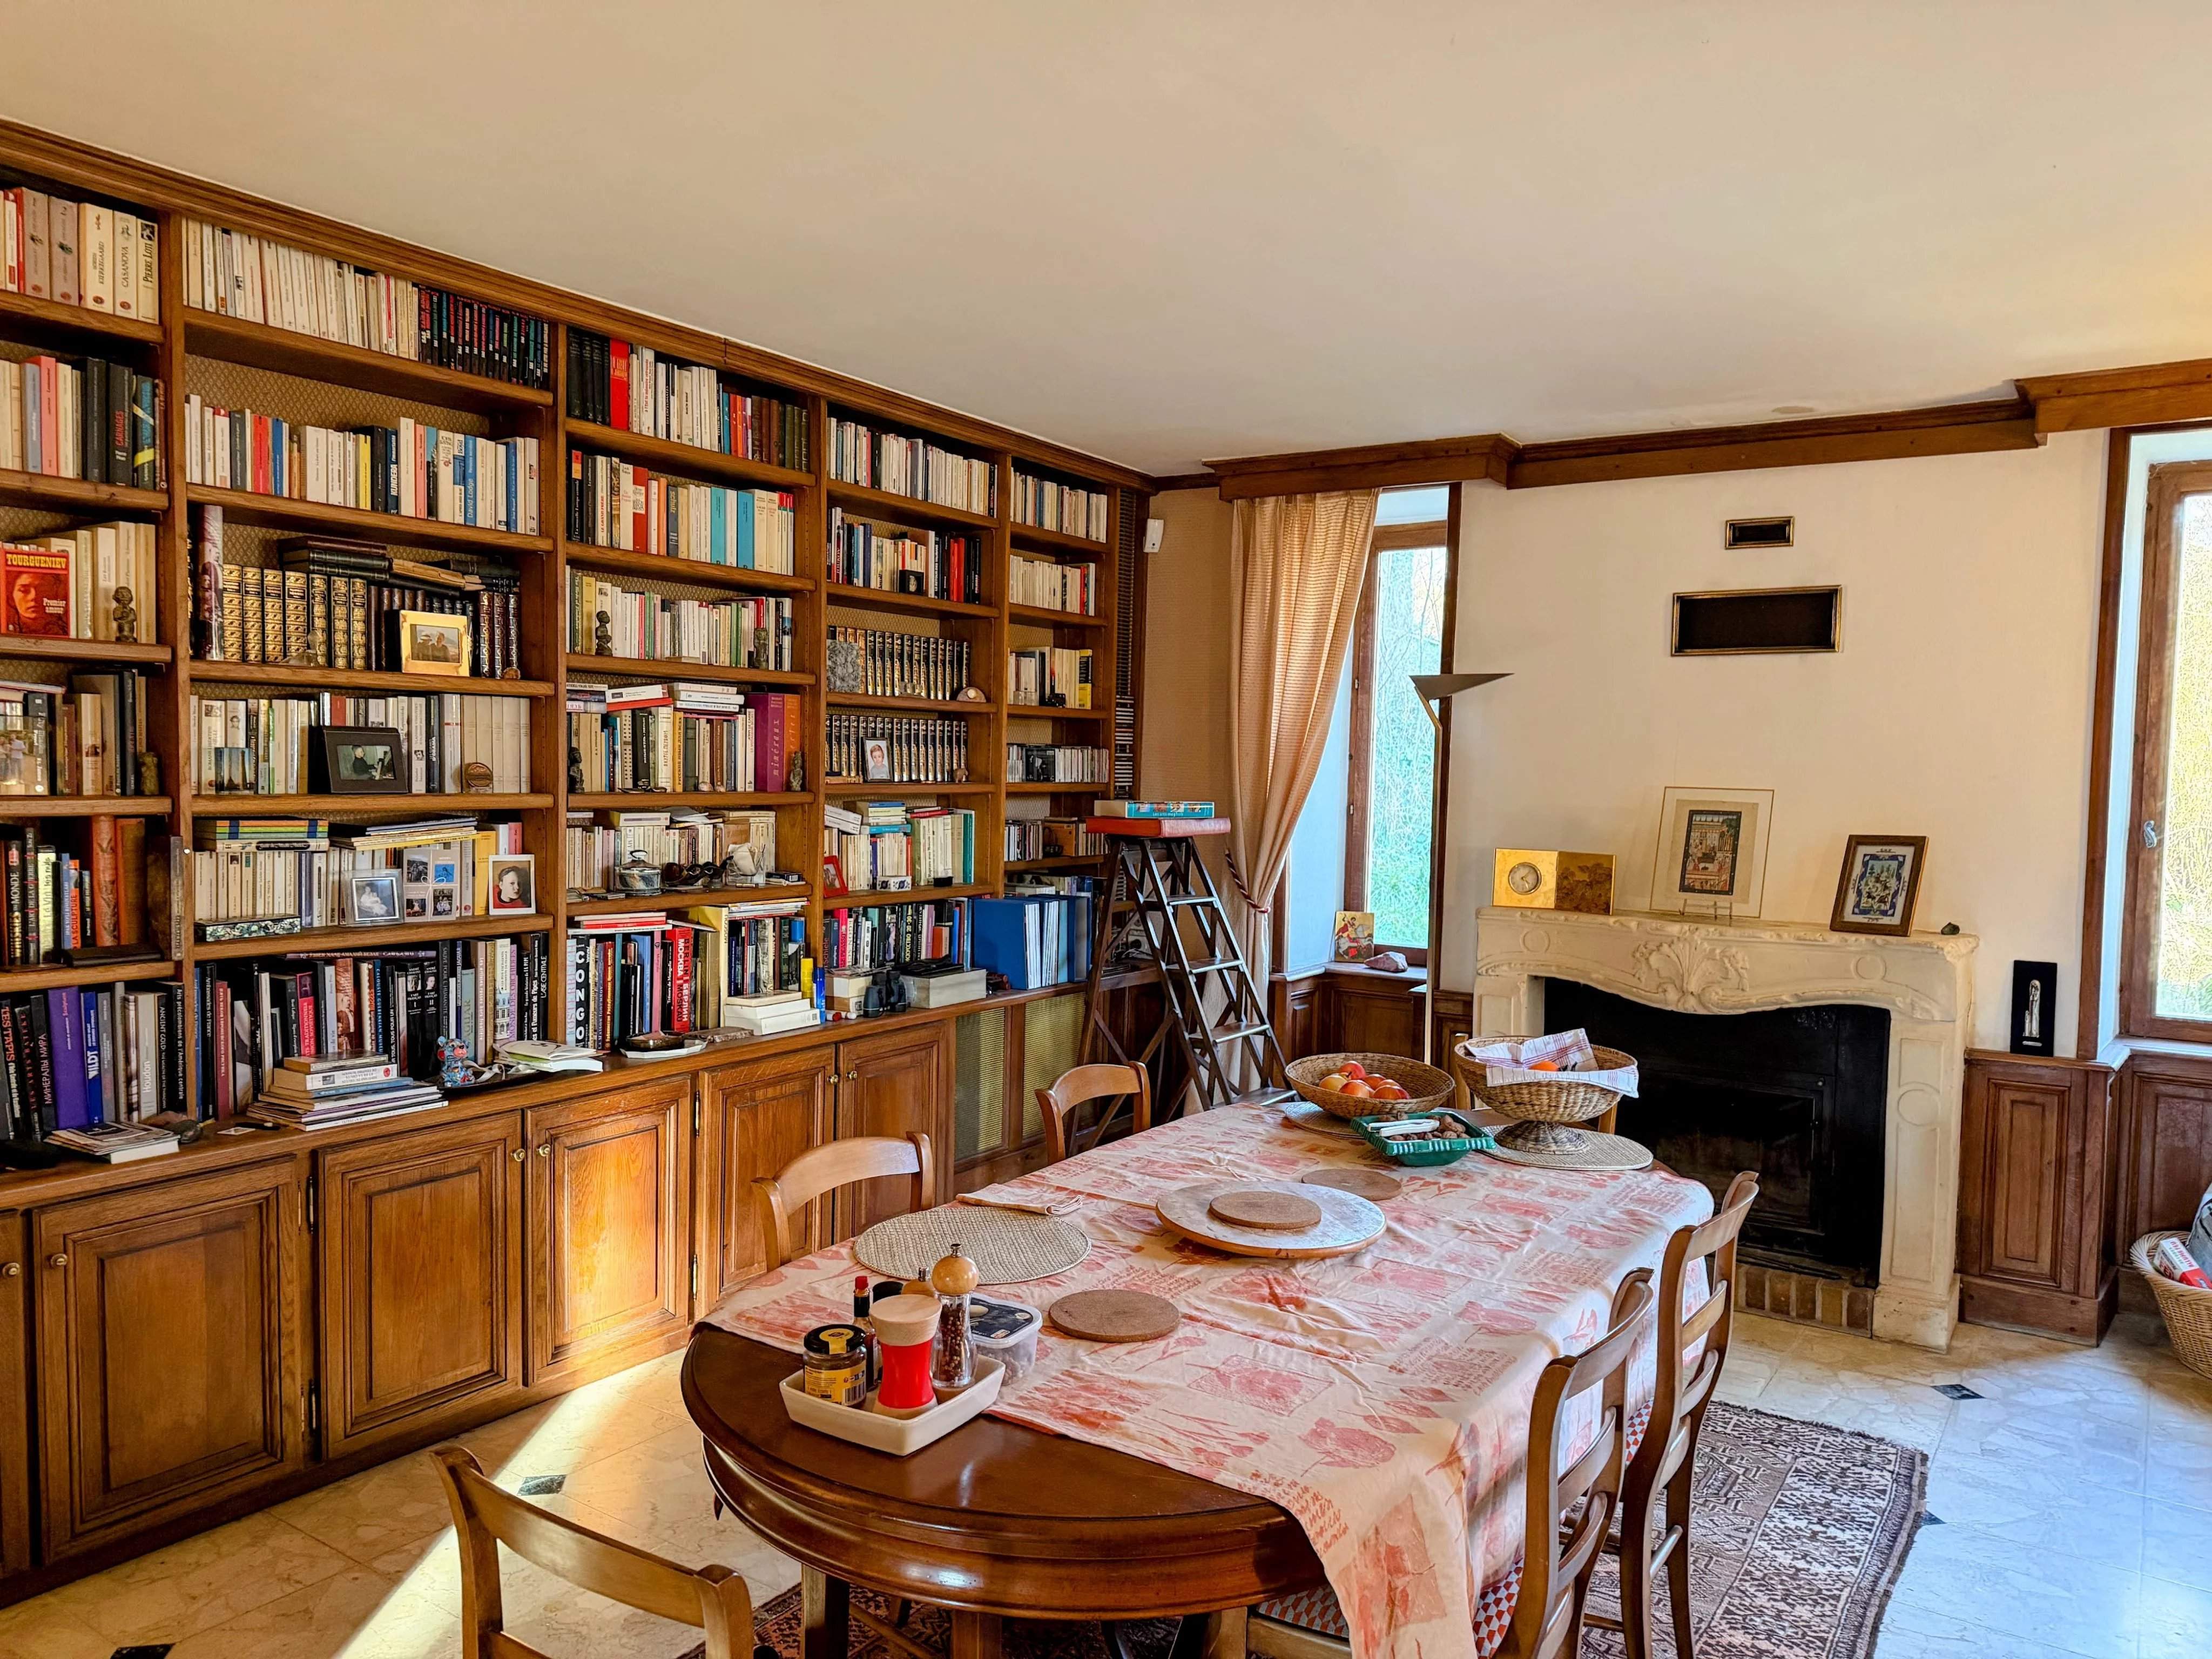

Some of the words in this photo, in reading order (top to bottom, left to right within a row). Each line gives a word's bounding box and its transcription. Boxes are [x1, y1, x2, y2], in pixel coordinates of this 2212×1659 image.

[143, 243, 152, 259] LOTI
[143, 259, 153, 283] PIERRE
[5, 554, 66, 569] TOURGUENIEV
[43, 598, 66, 606] Premier
[10, 872, 20, 904] MONDE
[28, 899, 35, 907] DE
[72, 936, 78, 945] LA
[576, 950, 585, 1039] CONGO
[1, 1006, 10, 1027] LES
[4, 1029, 15, 1061] TAPIS
[39, 1034, 48, 1057] МИРА
[87, 1050, 99, 1079] WILDT
[41, 1060, 52, 1104] МИНЕРАЛЫ
[142, 1061, 151, 1092] Houdon
